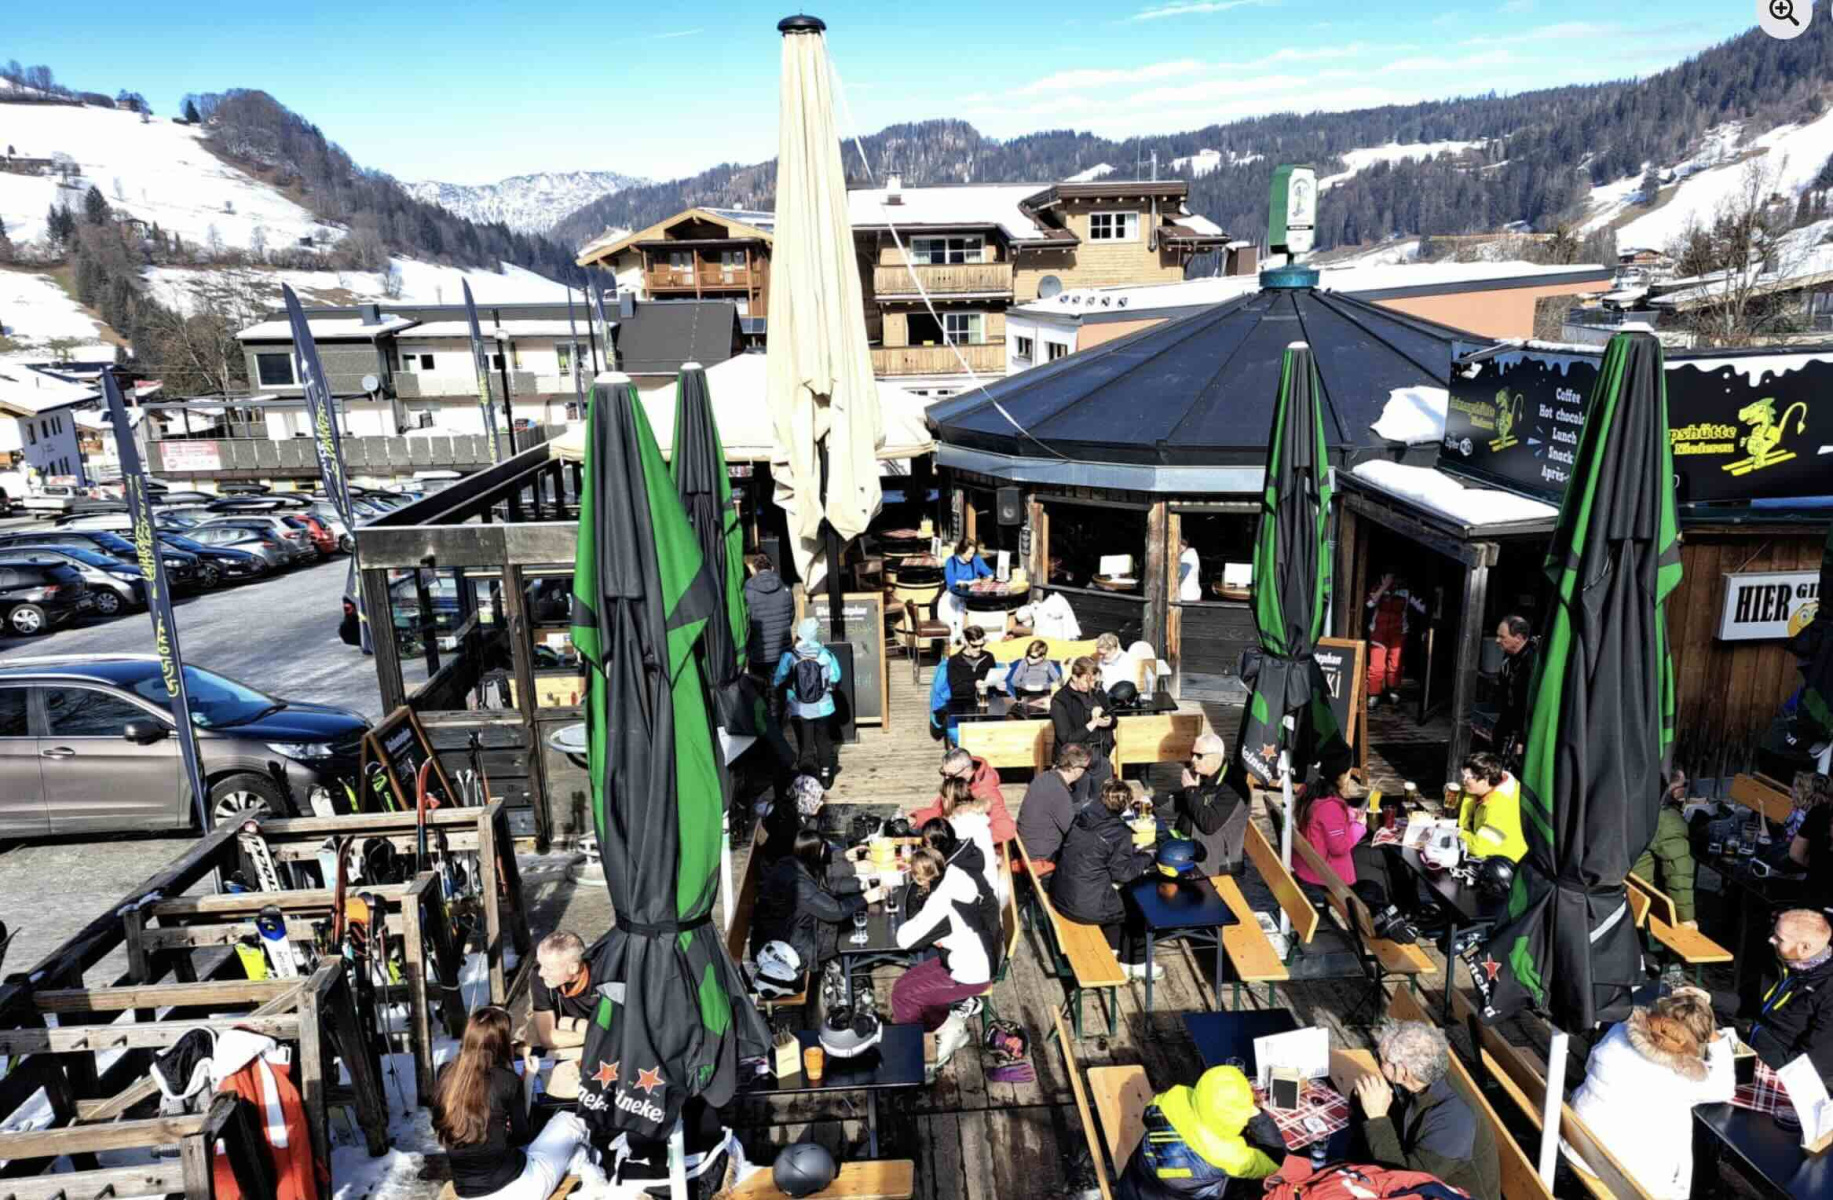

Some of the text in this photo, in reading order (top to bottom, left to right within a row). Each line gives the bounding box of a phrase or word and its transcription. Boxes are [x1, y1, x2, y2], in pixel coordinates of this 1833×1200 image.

[1556, 387, 1582, 404] Coffee
[1539, 403, 1553, 419] Hot
[1552, 426, 1577, 445] Lunch
[1669, 423, 1737, 445] pshütte
[1541, 464, 1570, 482] Après-
[1734, 584, 1792, 623] HIER
